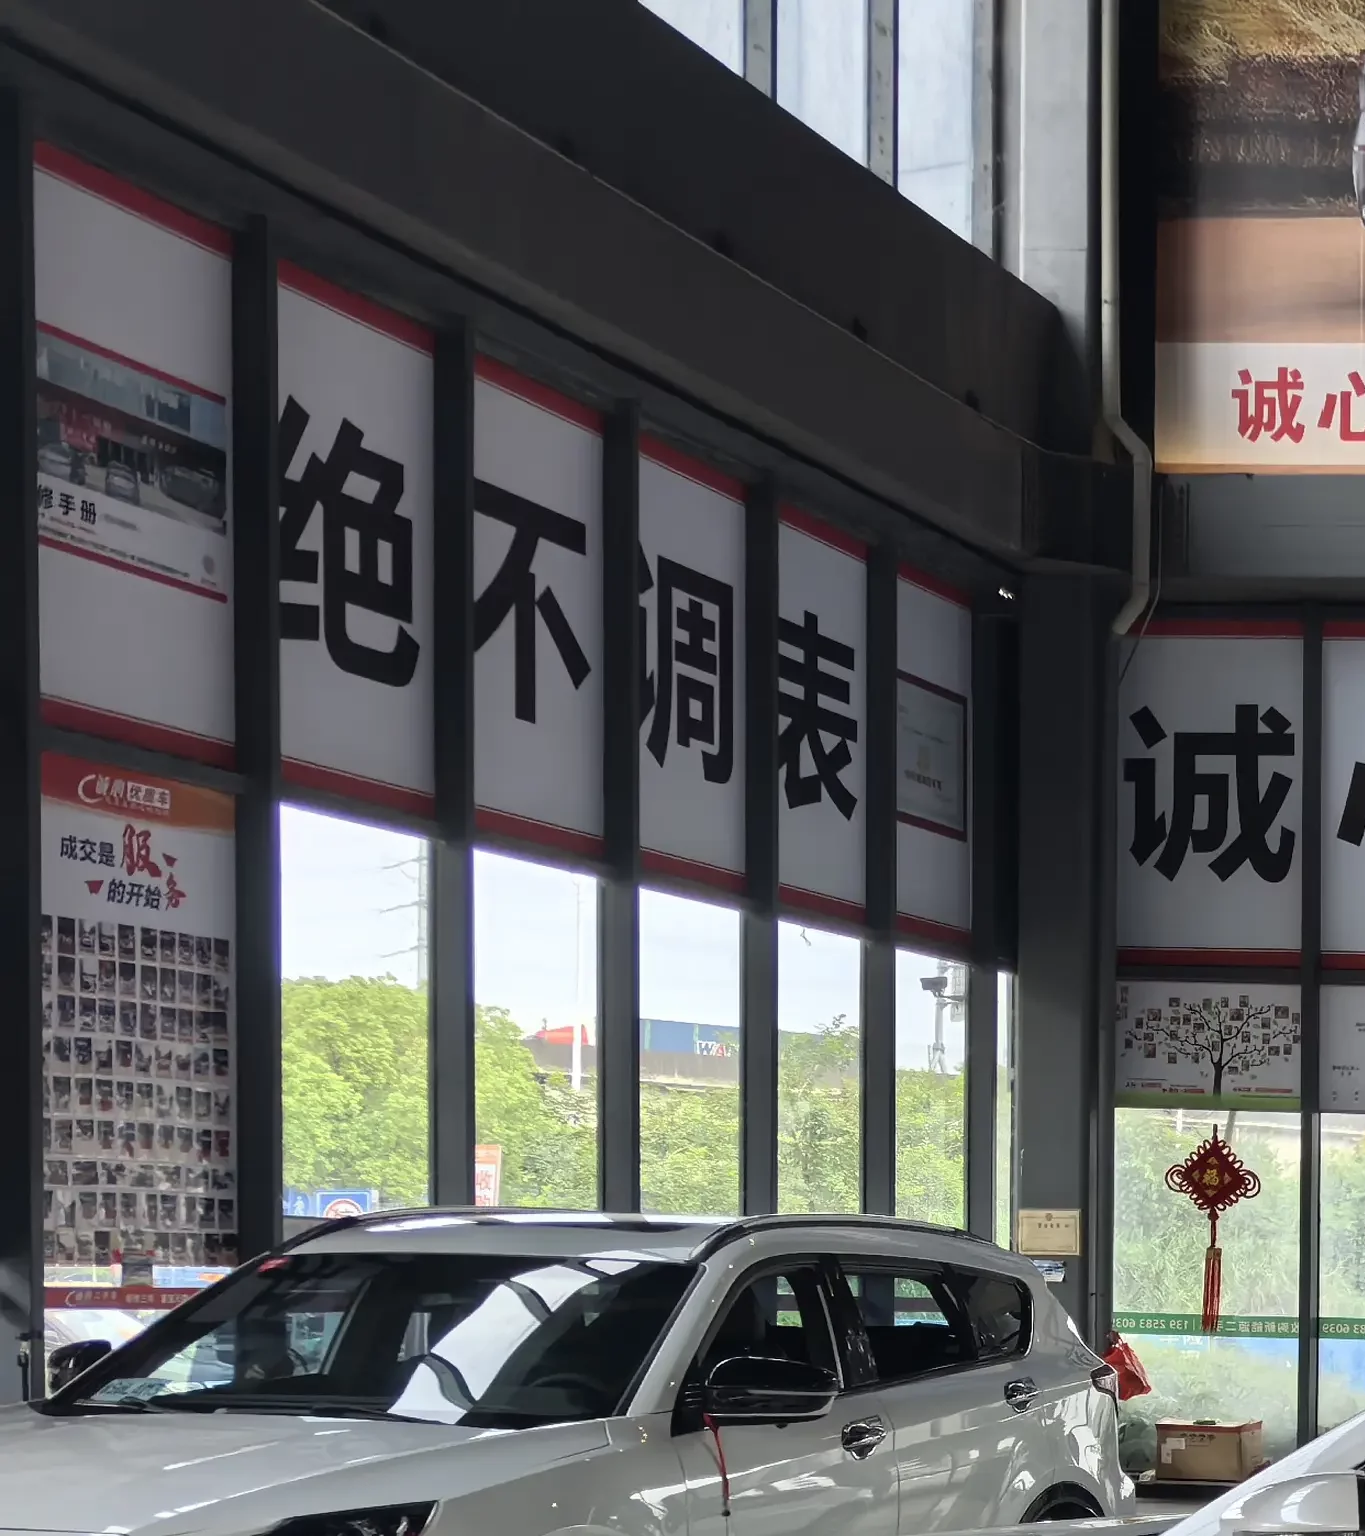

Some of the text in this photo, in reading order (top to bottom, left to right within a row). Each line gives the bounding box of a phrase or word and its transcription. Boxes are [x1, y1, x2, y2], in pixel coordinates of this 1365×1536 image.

[60, 835, 116, 868] 成交是
[106, 878, 162, 911] 的开始
[1202, 1168, 1220, 1187] 福
